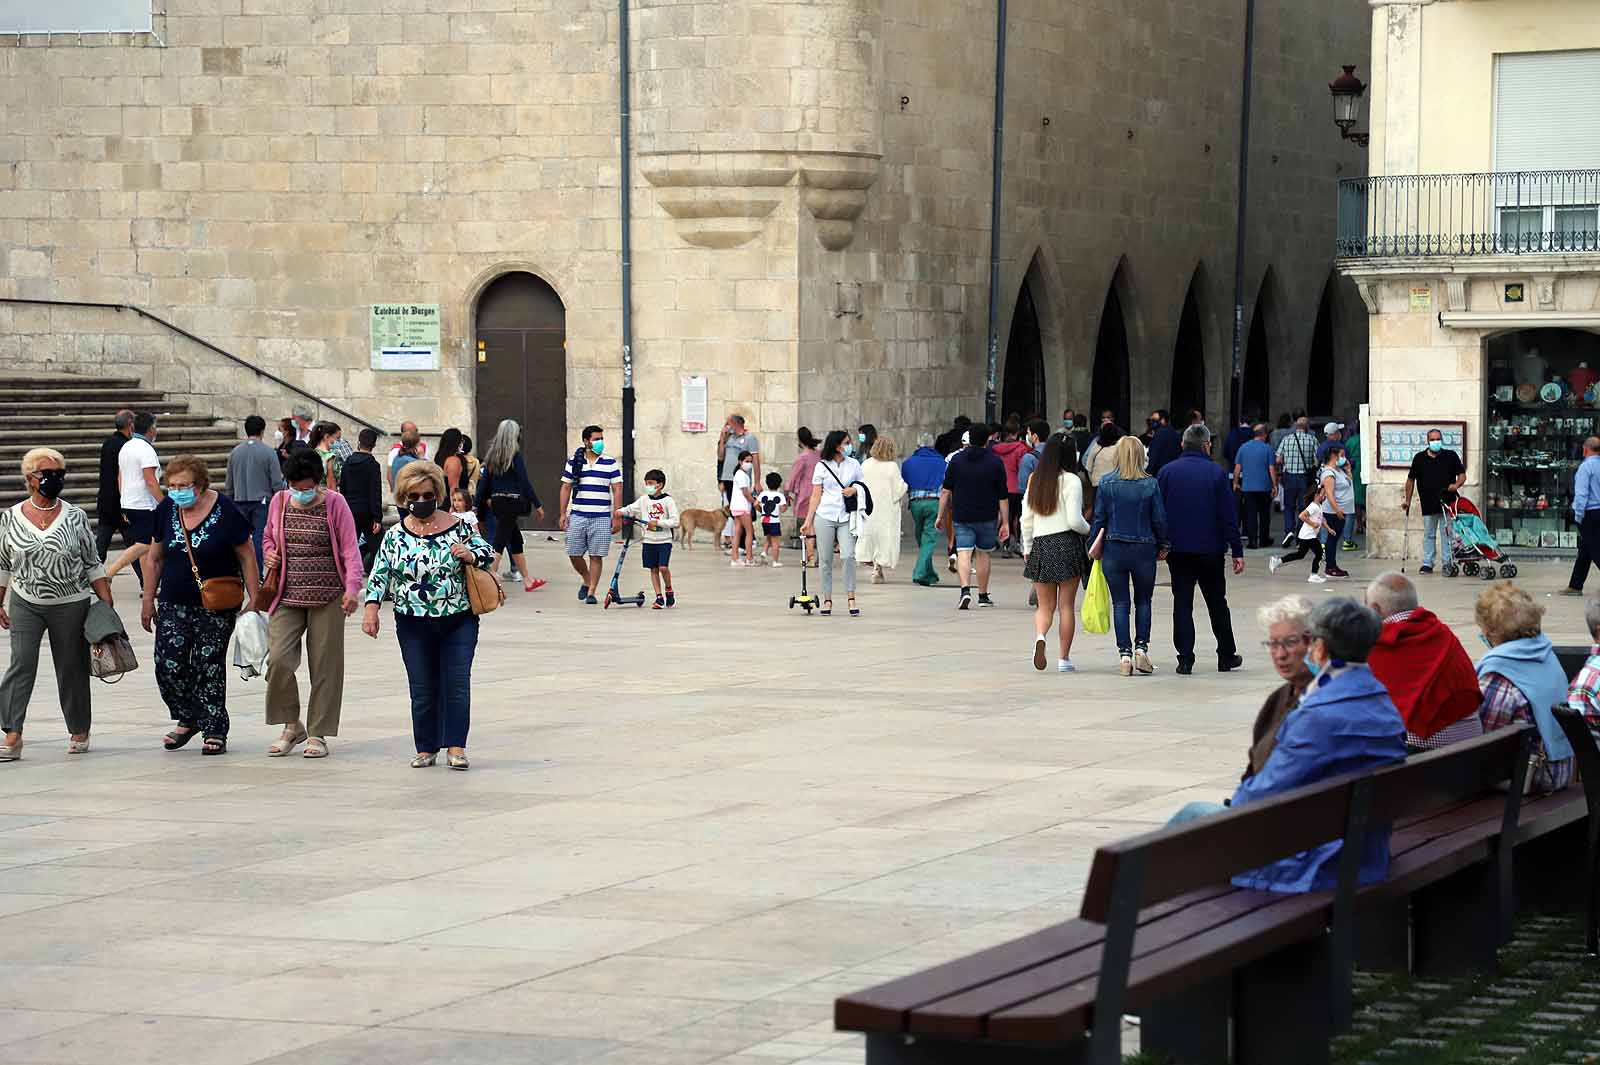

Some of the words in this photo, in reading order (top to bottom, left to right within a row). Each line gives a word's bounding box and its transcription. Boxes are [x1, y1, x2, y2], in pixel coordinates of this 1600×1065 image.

[374, 306, 400, 315] Catedral
[402, 306, 409, 315] de
[410, 306, 435, 316] Burgos
